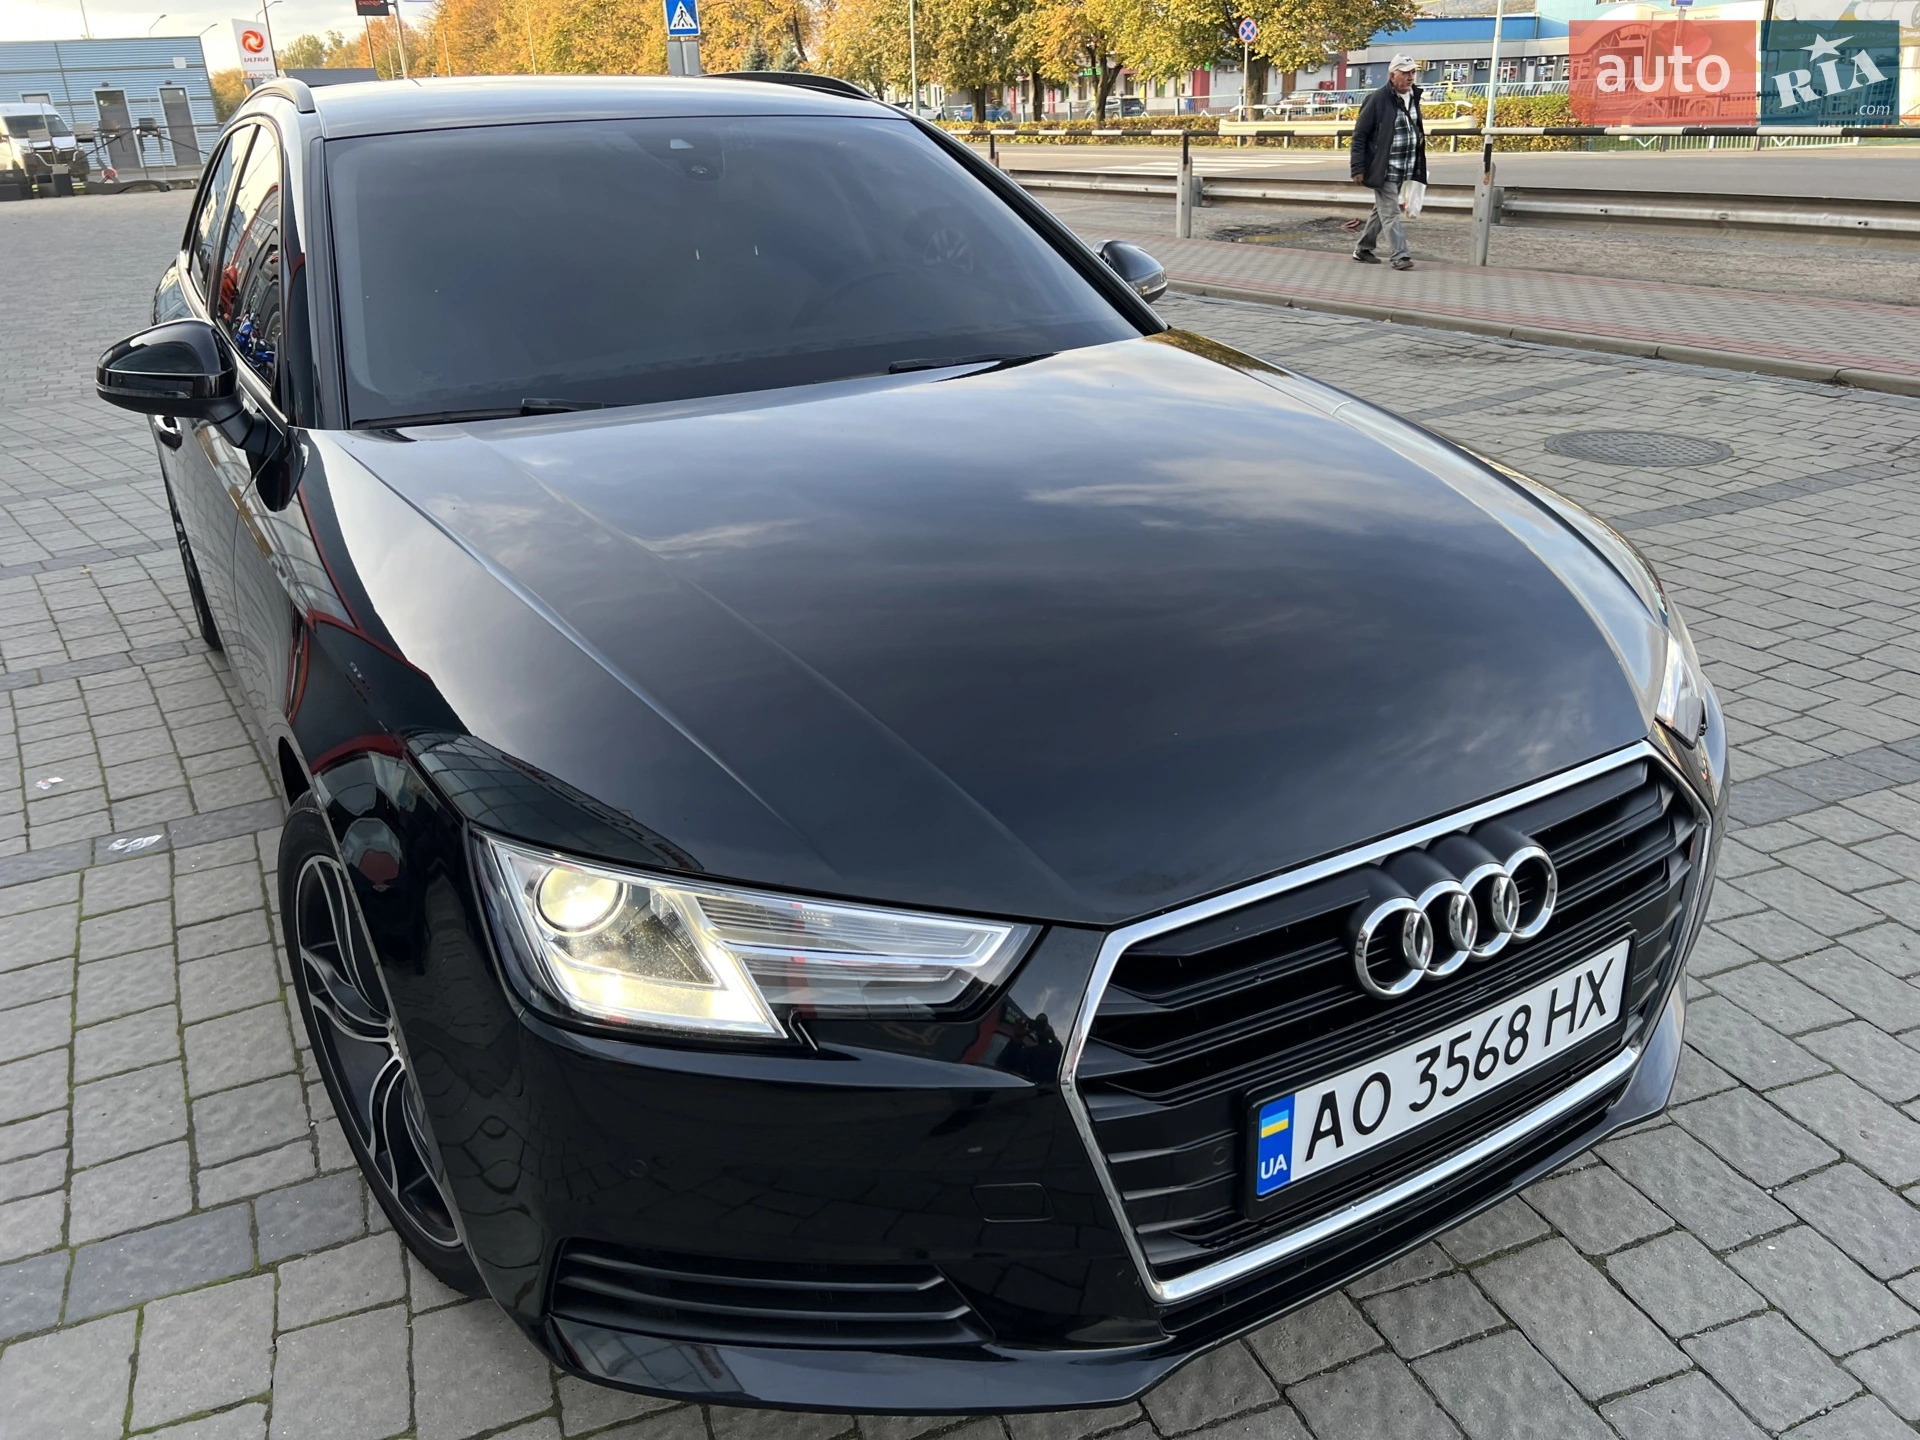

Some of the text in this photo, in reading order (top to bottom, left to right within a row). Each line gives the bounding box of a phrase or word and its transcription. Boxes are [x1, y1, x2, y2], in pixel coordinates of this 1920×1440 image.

[1304, 957, 1614, 1162] AO 3568 HX
[1260, 1152, 1288, 1181] UA
